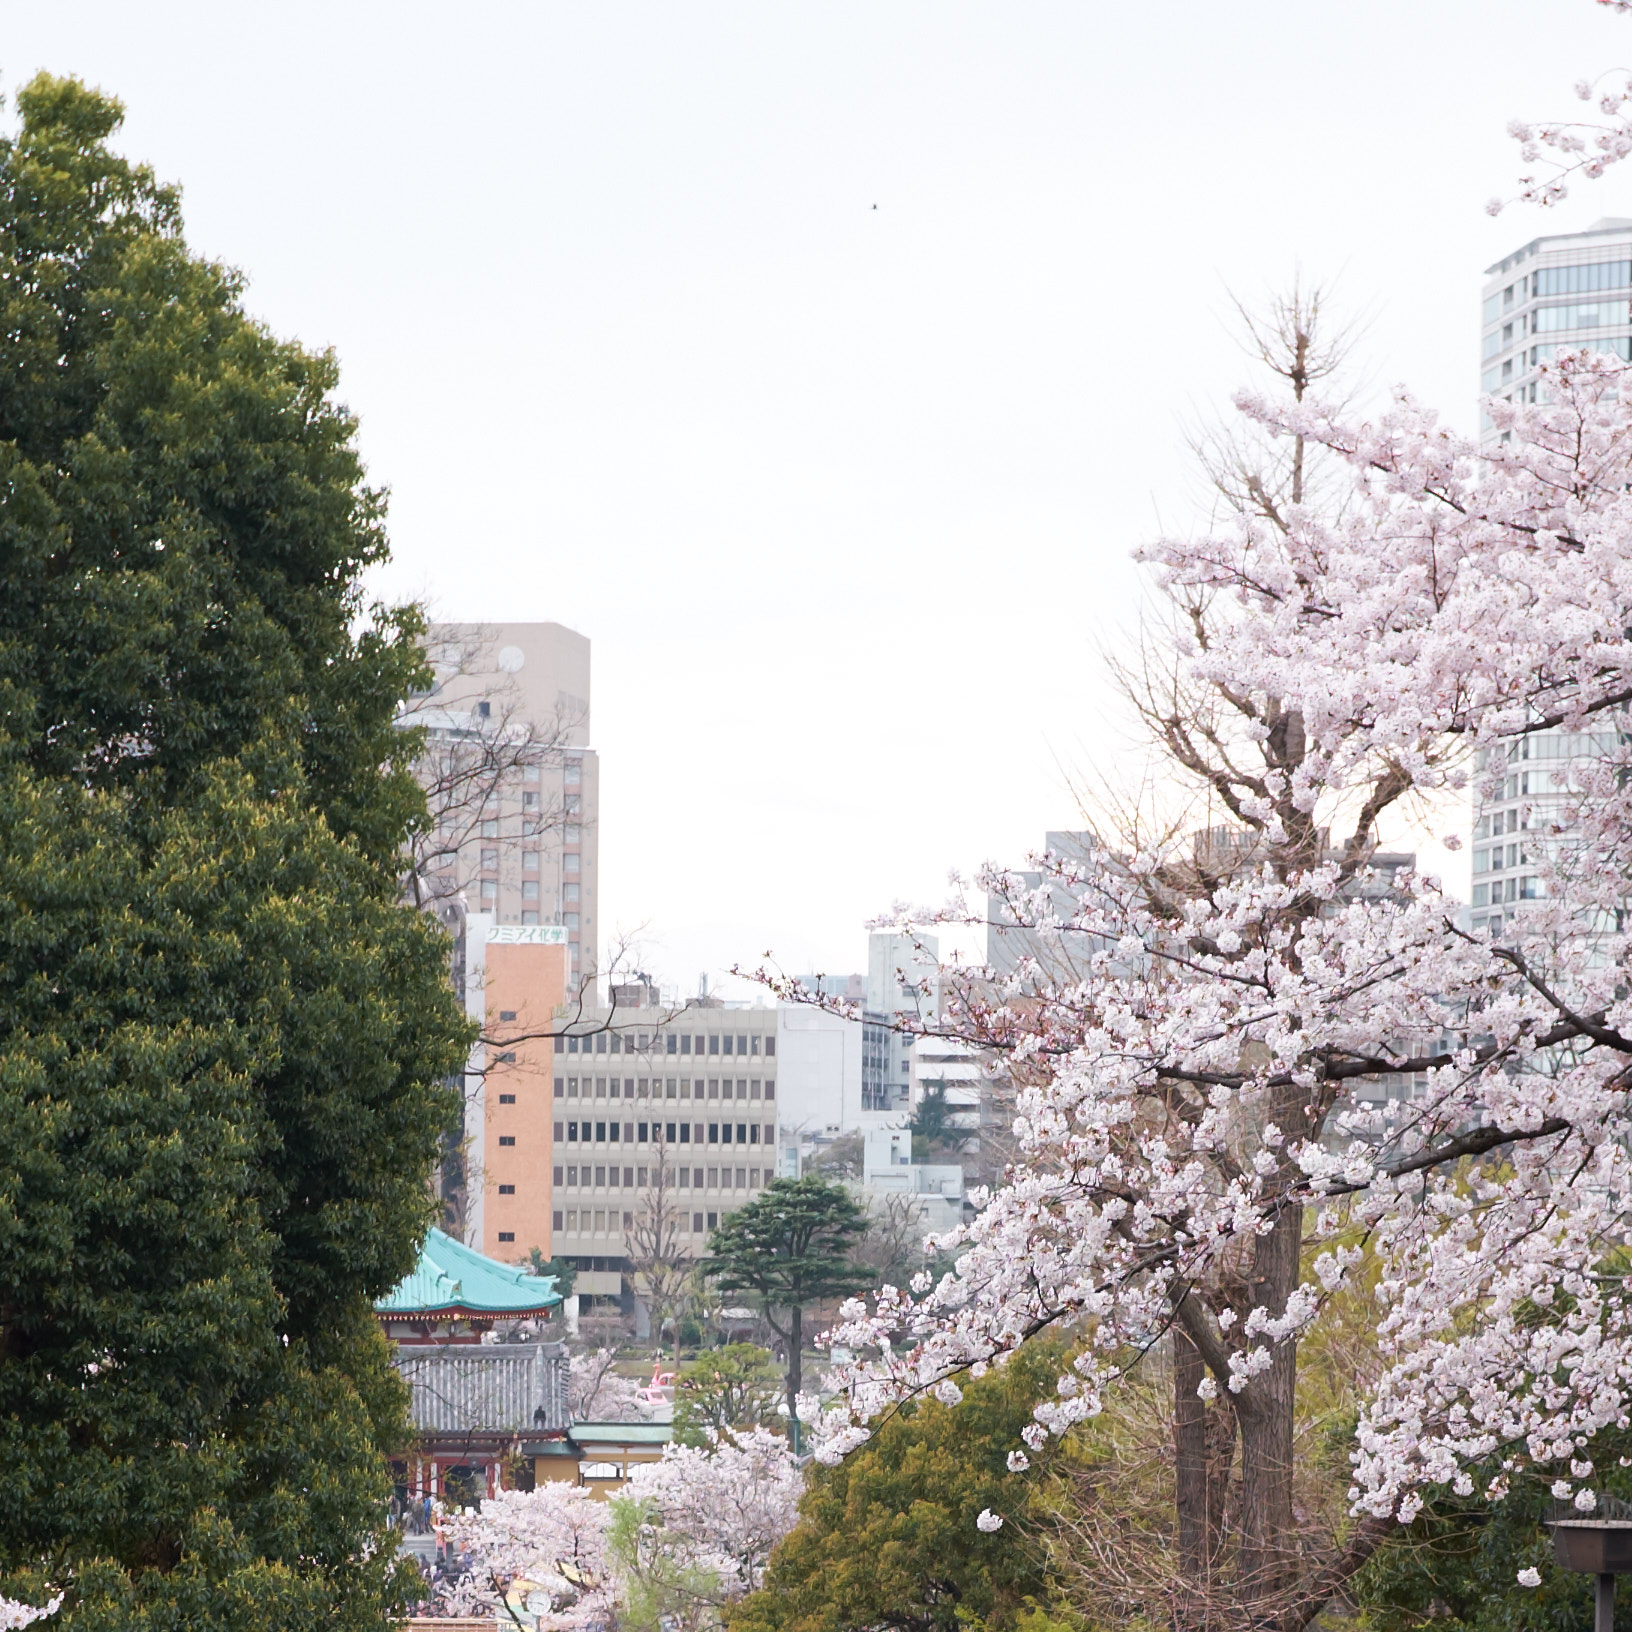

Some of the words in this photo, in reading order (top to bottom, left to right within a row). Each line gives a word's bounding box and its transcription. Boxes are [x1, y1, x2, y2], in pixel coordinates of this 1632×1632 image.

[488, 927, 563, 941] クミアイ化学
